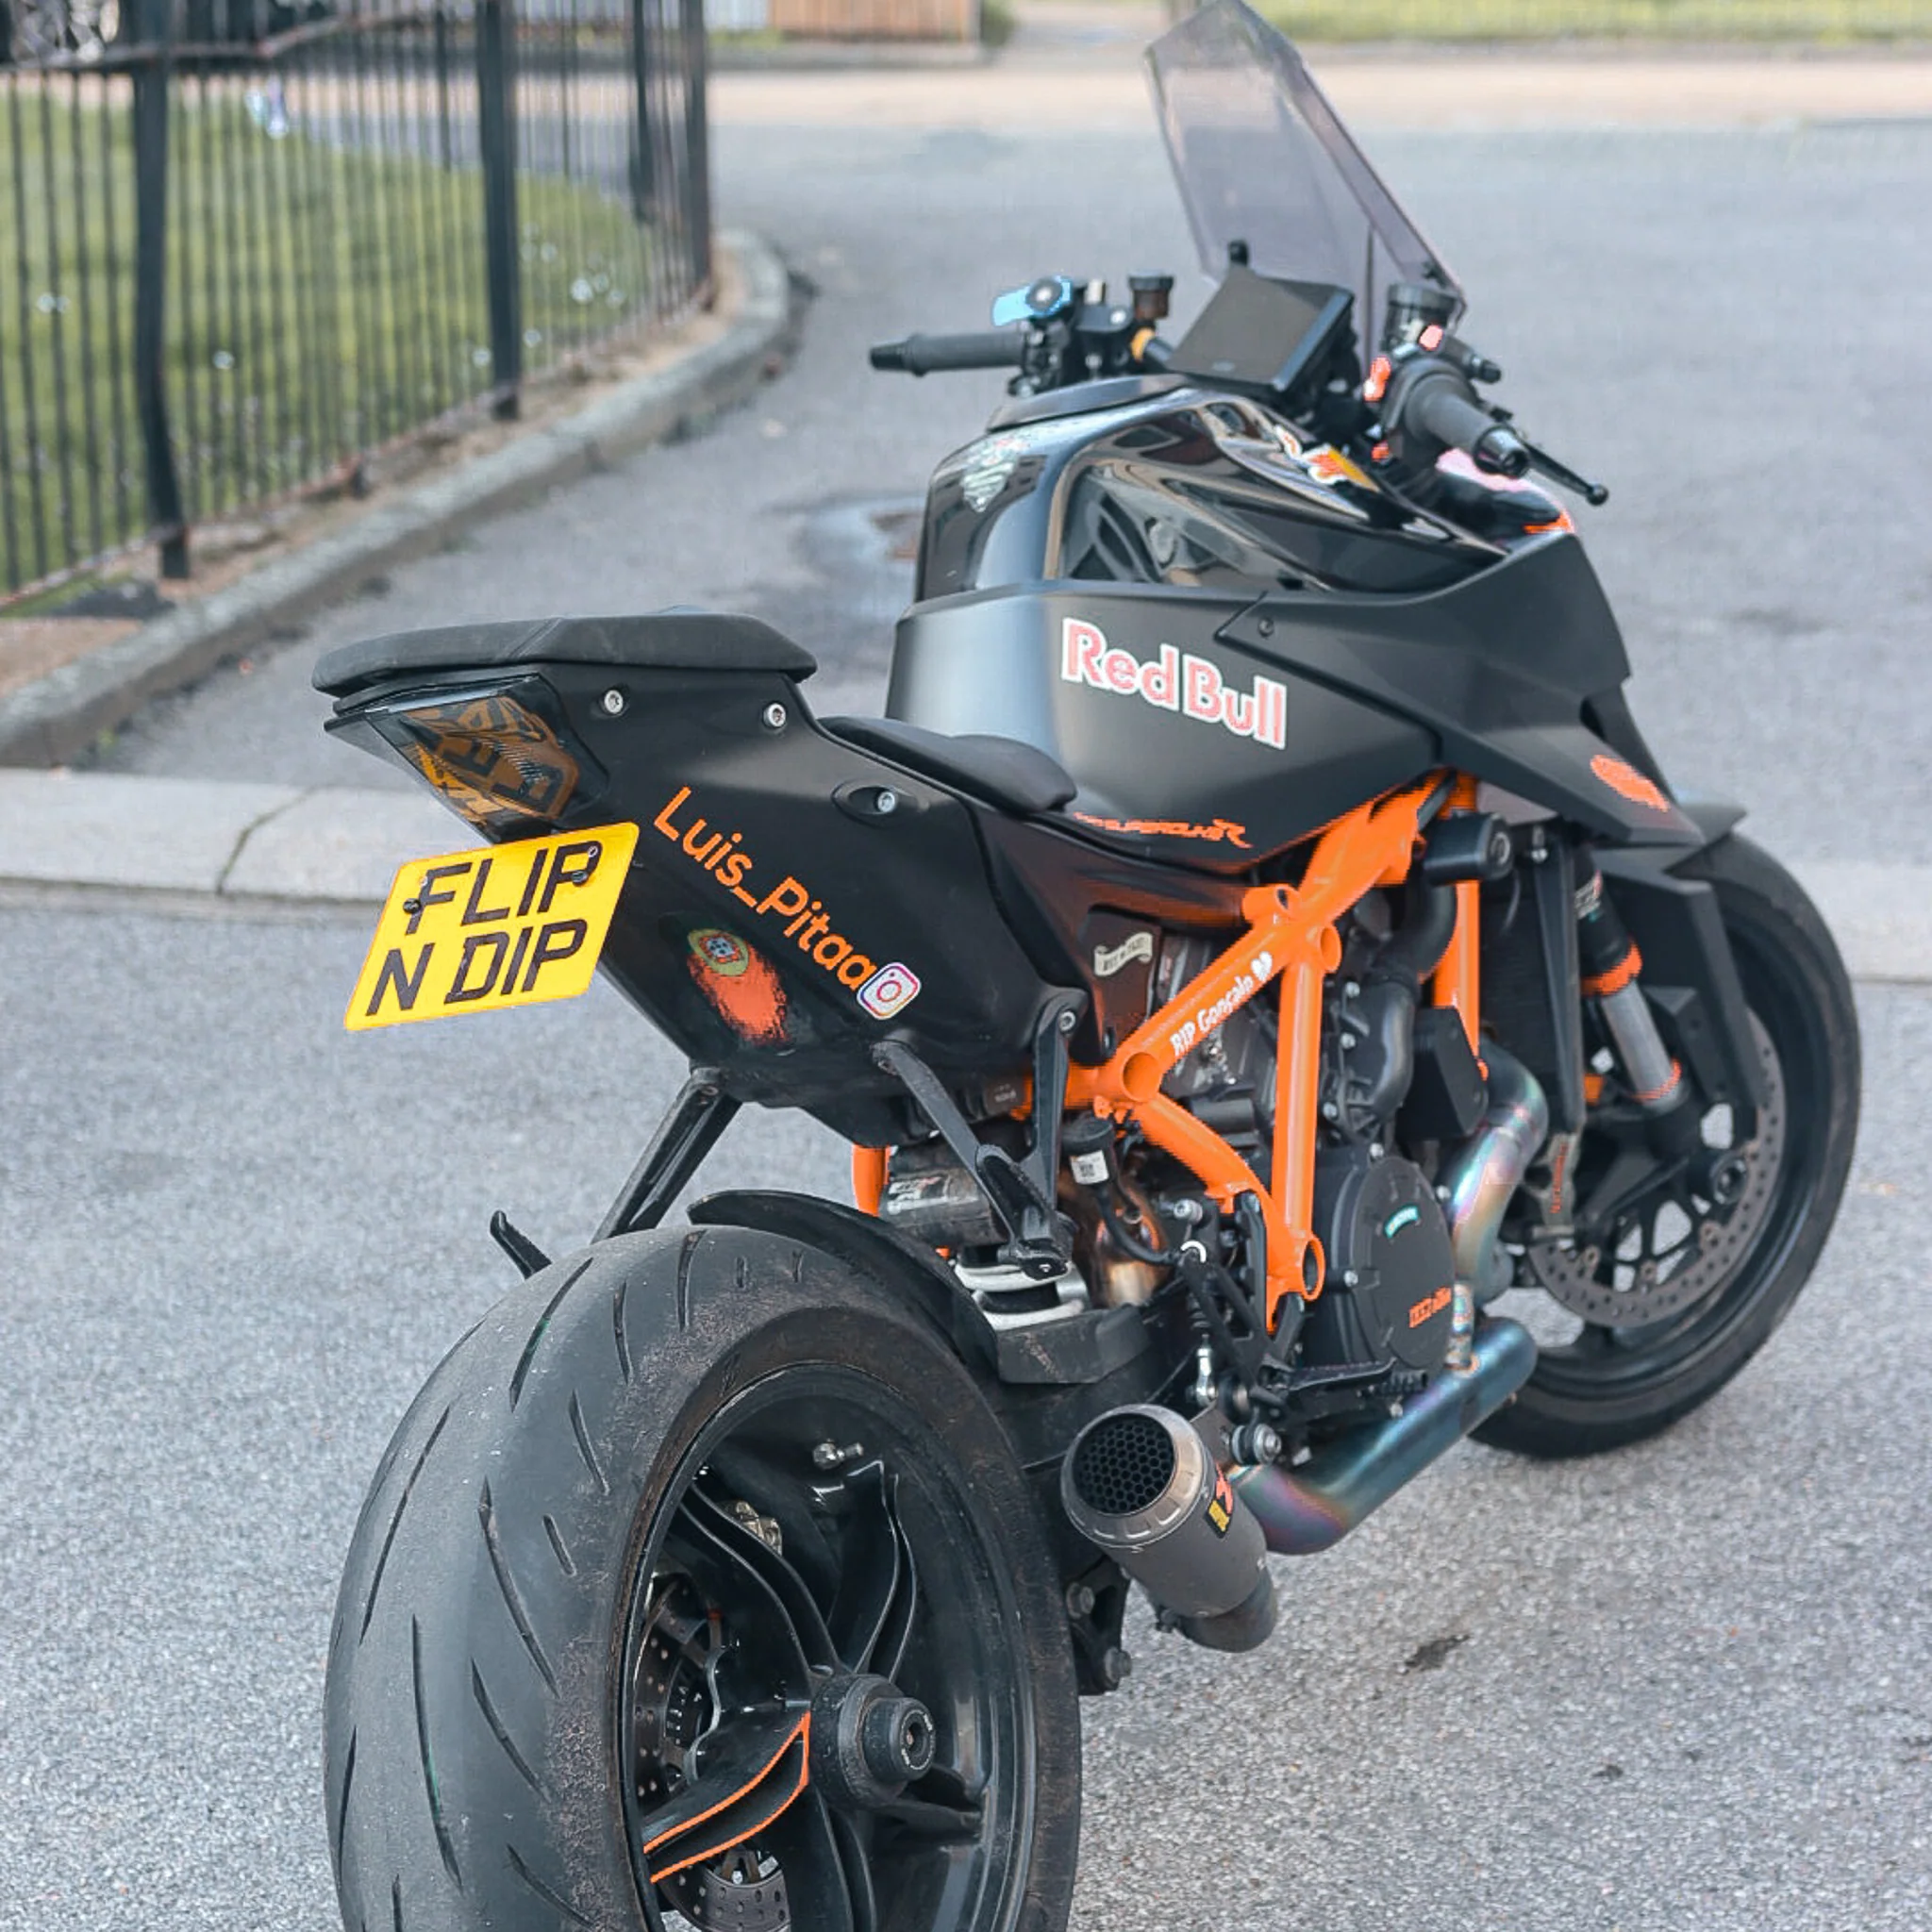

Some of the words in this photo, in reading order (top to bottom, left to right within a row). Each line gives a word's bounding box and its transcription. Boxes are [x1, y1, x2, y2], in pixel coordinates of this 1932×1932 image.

[1061, 617, 1179, 712] Red
[1183, 654, 1287, 750] Bull
[405, 840, 603, 936] FLIP
[653, 787, 878, 991] Luis_Pitaa
[366, 943, 433, 1017] N
[443, 919, 588, 1005] DIP
[1170, 1021, 1196, 1057] RIP
